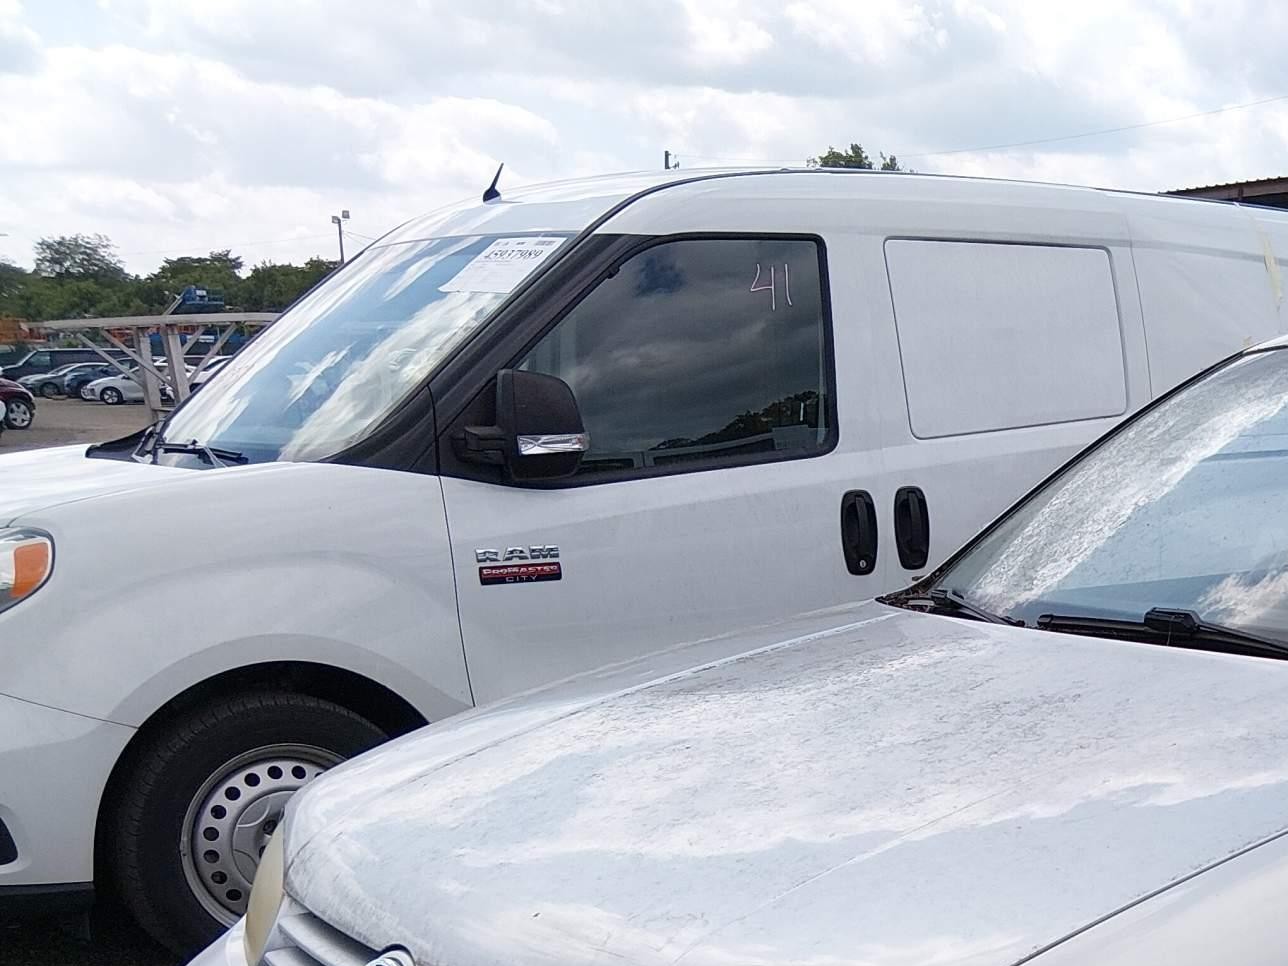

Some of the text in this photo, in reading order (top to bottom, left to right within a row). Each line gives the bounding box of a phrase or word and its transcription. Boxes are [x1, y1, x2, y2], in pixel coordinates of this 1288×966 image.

[750, 263, 793, 311] 41
[475, 545, 560, 563] RAM
[505, 574, 538, 583] CITY
